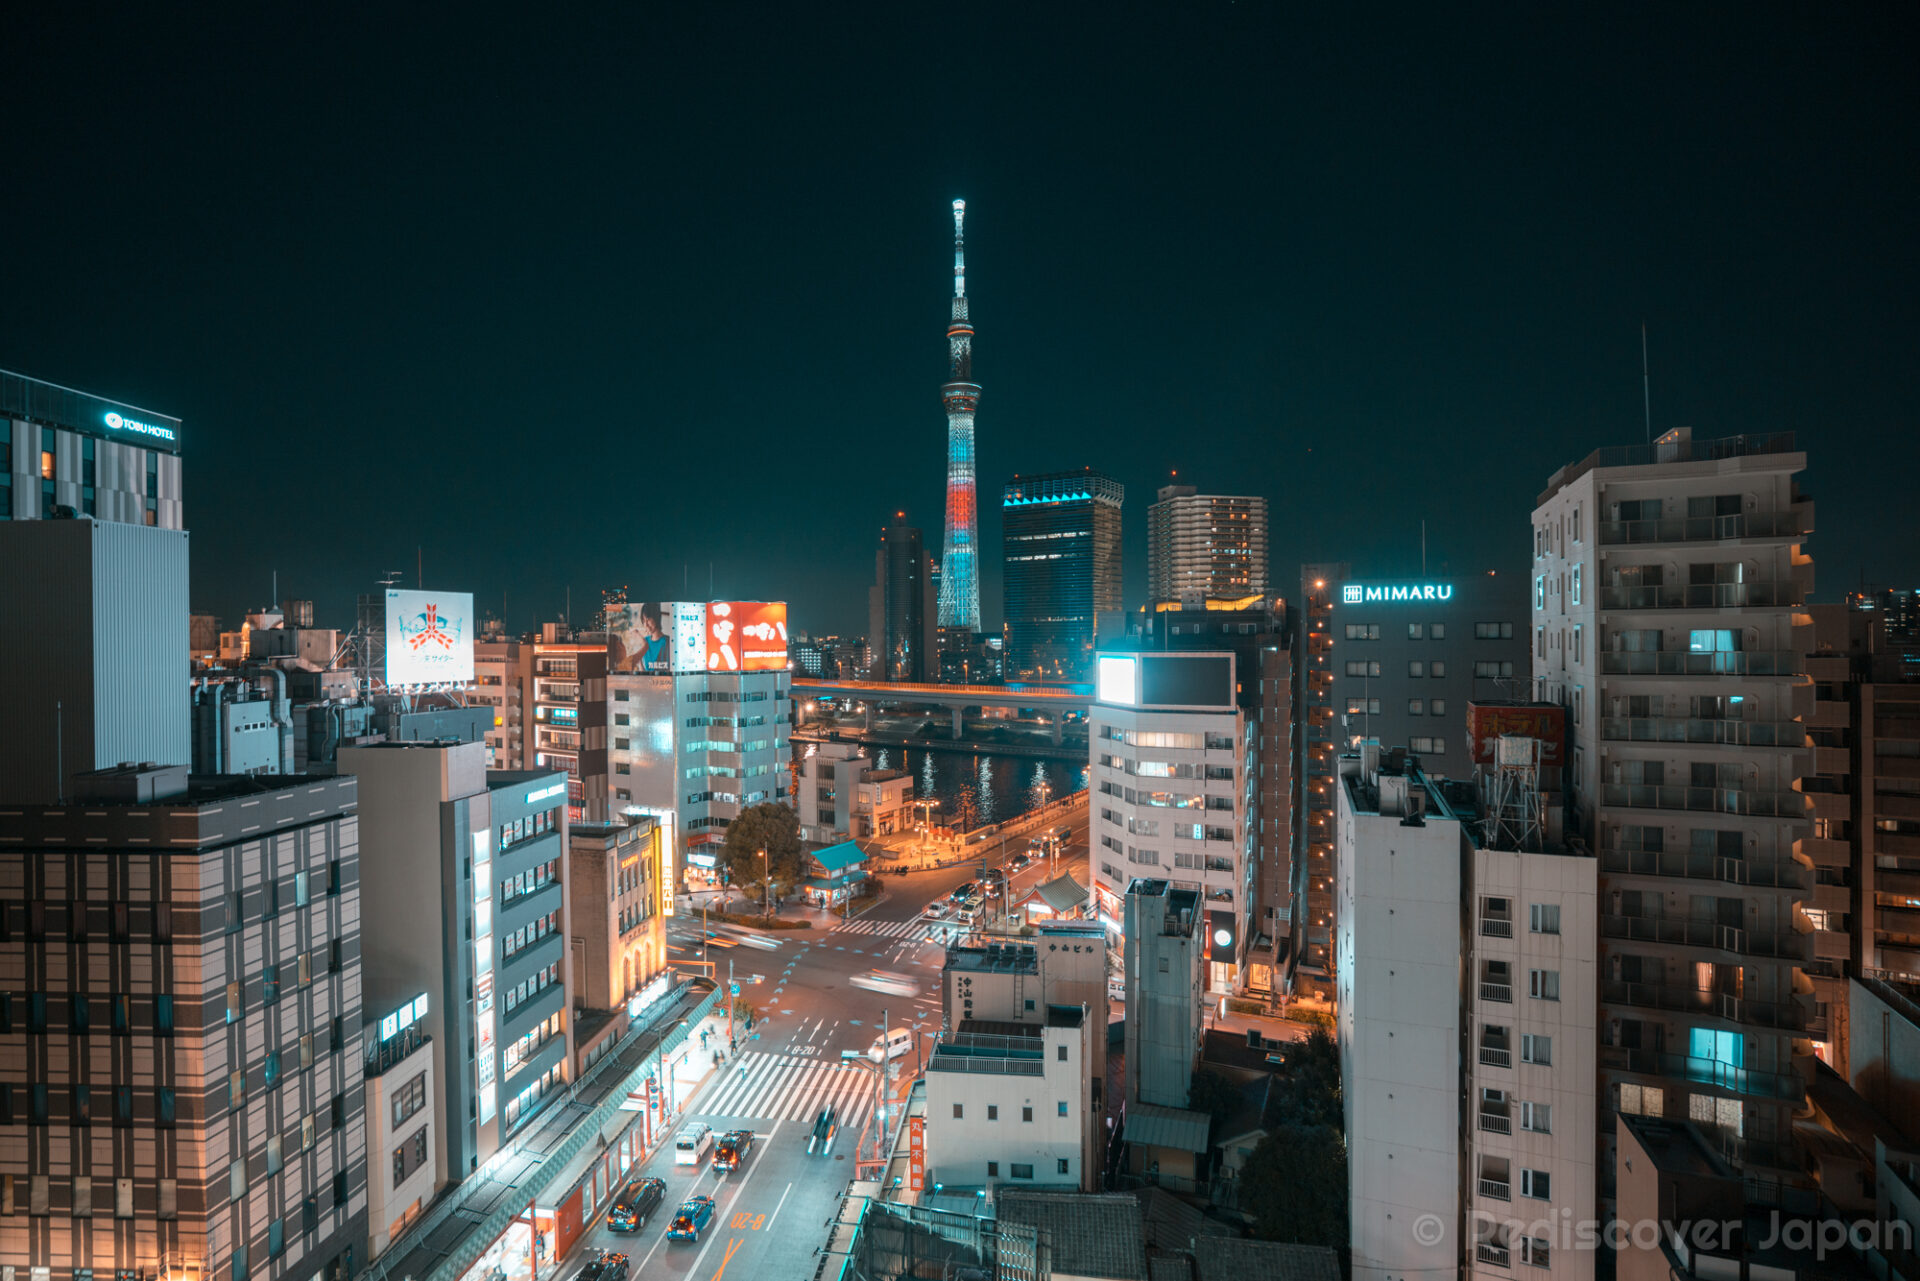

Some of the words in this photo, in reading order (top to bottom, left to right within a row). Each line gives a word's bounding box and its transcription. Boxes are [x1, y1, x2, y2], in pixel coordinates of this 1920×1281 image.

[123, 419, 148, 433] TOBU
[148, 425, 175, 440] HOTEL
[1366, 585, 1452, 601] MIMARU
[1049, 943, 1094, 954] 中山ビル
[791, 1045, 816, 1055] 8-20
[730, 1212, 766, 1231] 8-20
